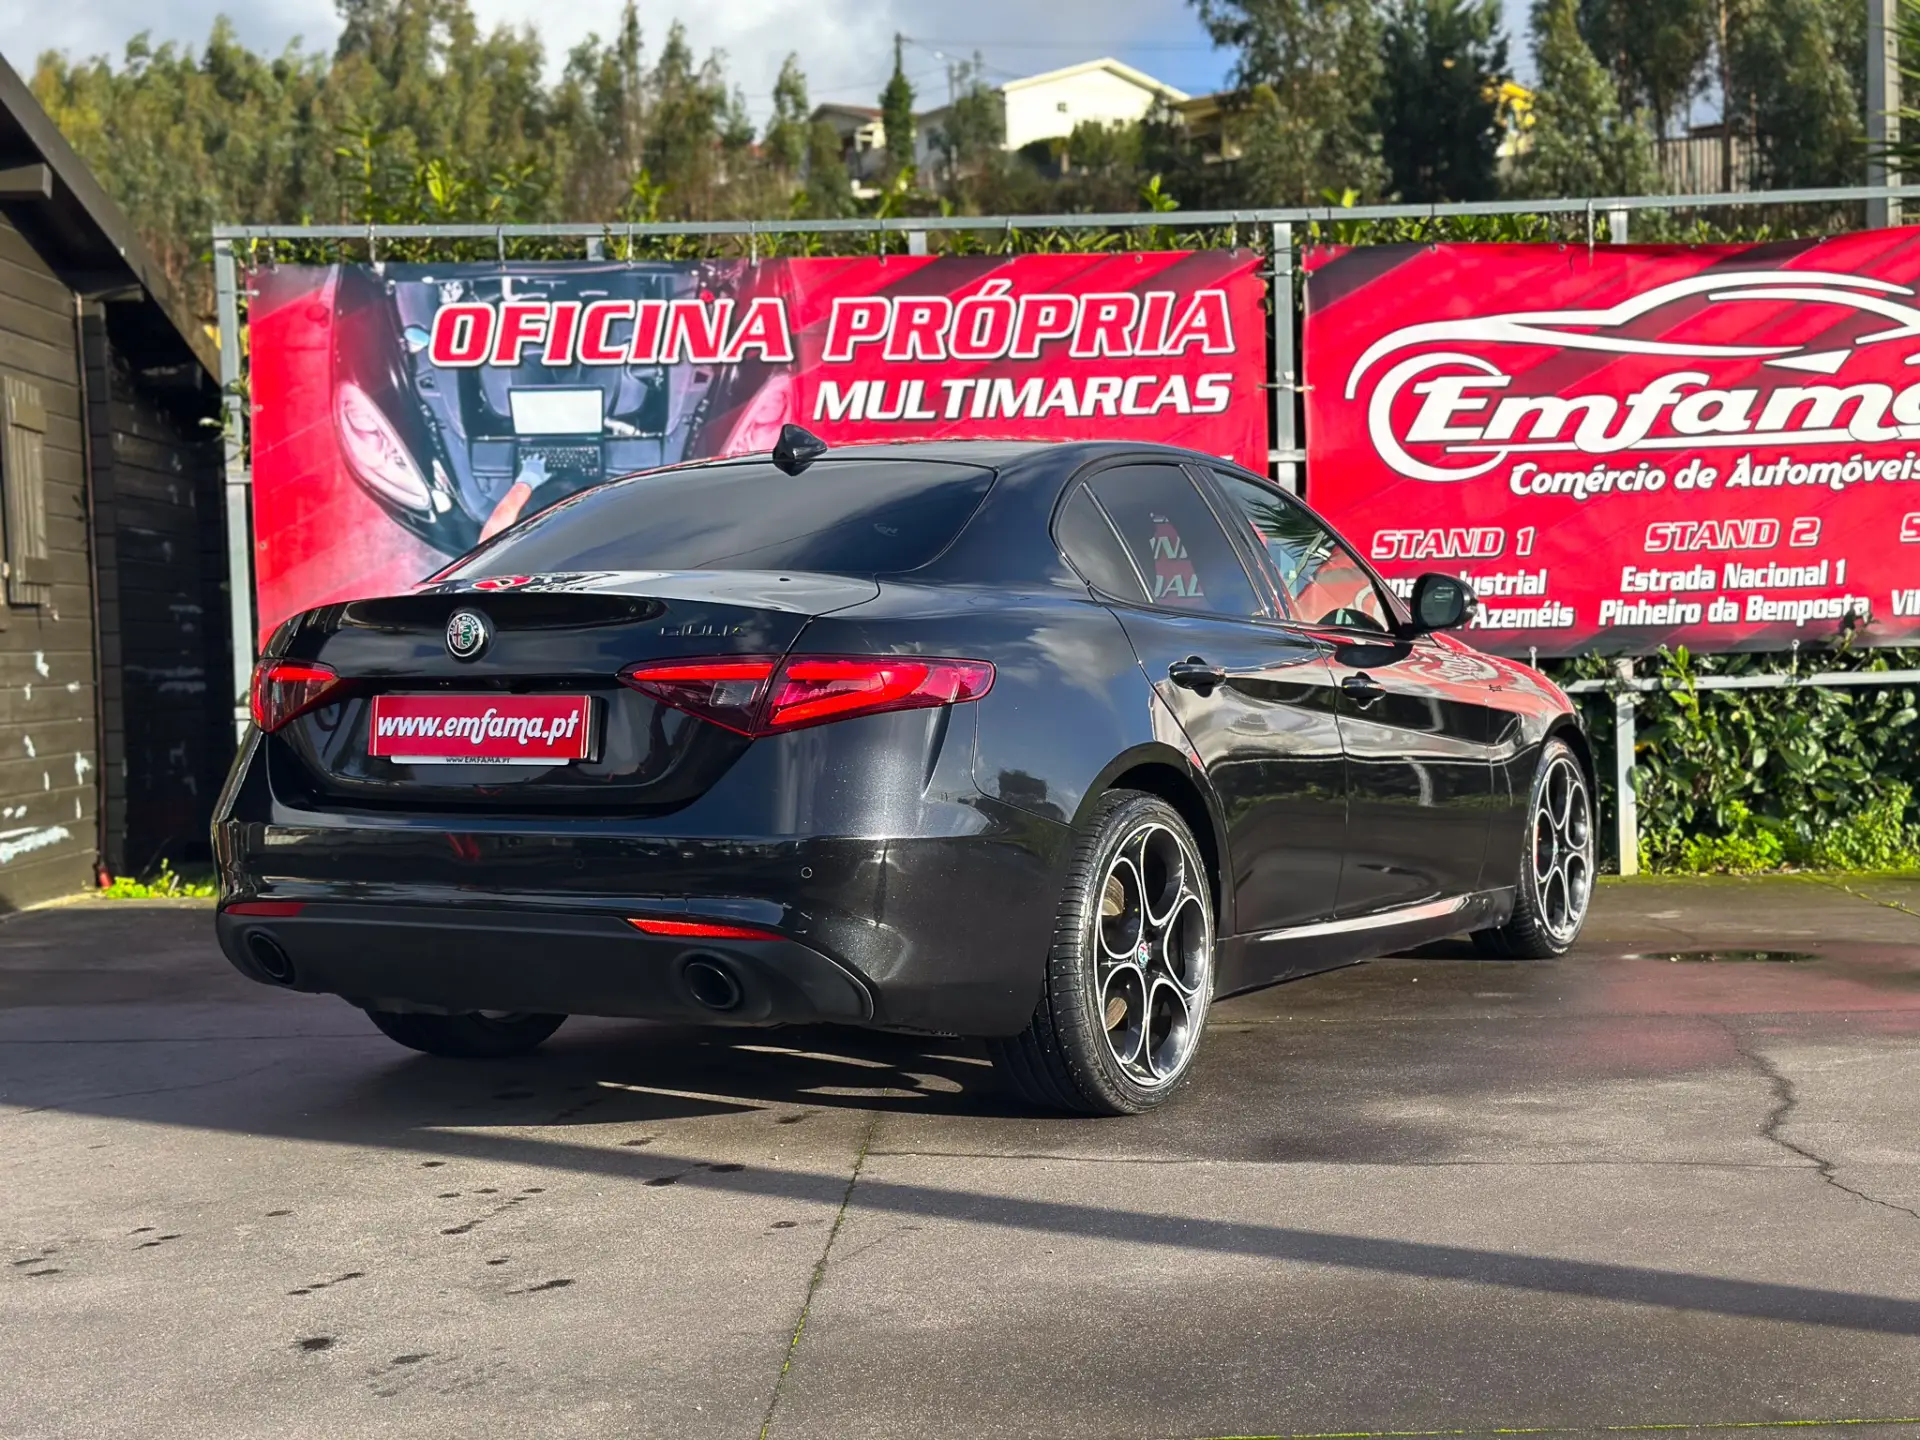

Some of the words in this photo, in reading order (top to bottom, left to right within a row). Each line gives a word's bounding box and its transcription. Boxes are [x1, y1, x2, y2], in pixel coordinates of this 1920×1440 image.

[429, 299, 796, 367] OFICINA
[821, 280, 1236, 362] PRÓPRIA
[813, 373, 1234, 421] MULTIMARCAS
[1509, 462, 1666, 500] Comércio
[1674, 458, 1717, 490] de
[1371, 528, 1505, 560] STAND
[1516, 526, 1536, 557] 1
[1644, 518, 1780, 552] STAND
[1789, 516, 1821, 547] 2
[1620, 566, 1716, 592] Estrada
[1722, 560, 1830, 589] Nacional
[1834, 559, 1847, 585] 1
[1470, 601, 1575, 630] Azeméis
[1598, 599, 1701, 626] Pinheiro
[1707, 596, 1739, 623] da
[1745, 594, 1871, 627] Bemposta
[378, 708, 579, 746] www.emfama.pt
